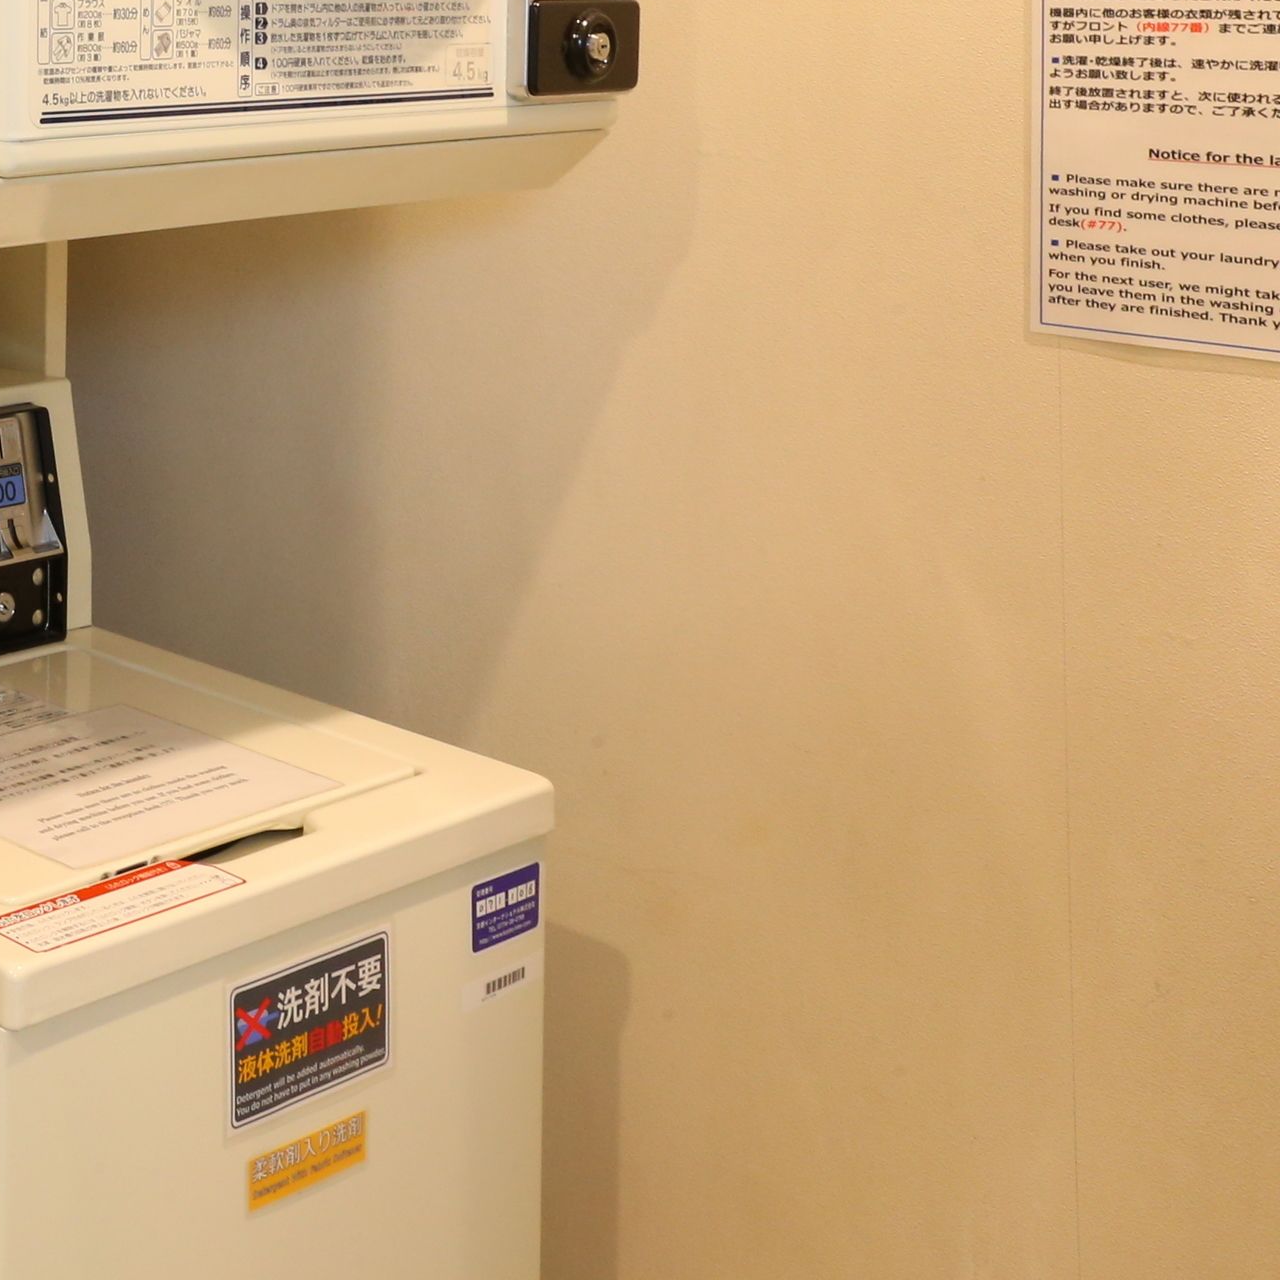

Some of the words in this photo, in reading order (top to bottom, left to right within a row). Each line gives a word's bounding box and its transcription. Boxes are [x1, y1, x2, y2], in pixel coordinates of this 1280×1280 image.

[1149, 148, 1201, 162] Notice
[1206, 151, 1230, 163] for
[1236, 153, 1264, 165] the
[276, 953, 382, 1030] 洗剤不要
[236, 1084, 273, 1105] Detergent
[273, 1076, 286, 1089] will
[252, 1117, 361, 1184] 柔軟剤入り洗剤
